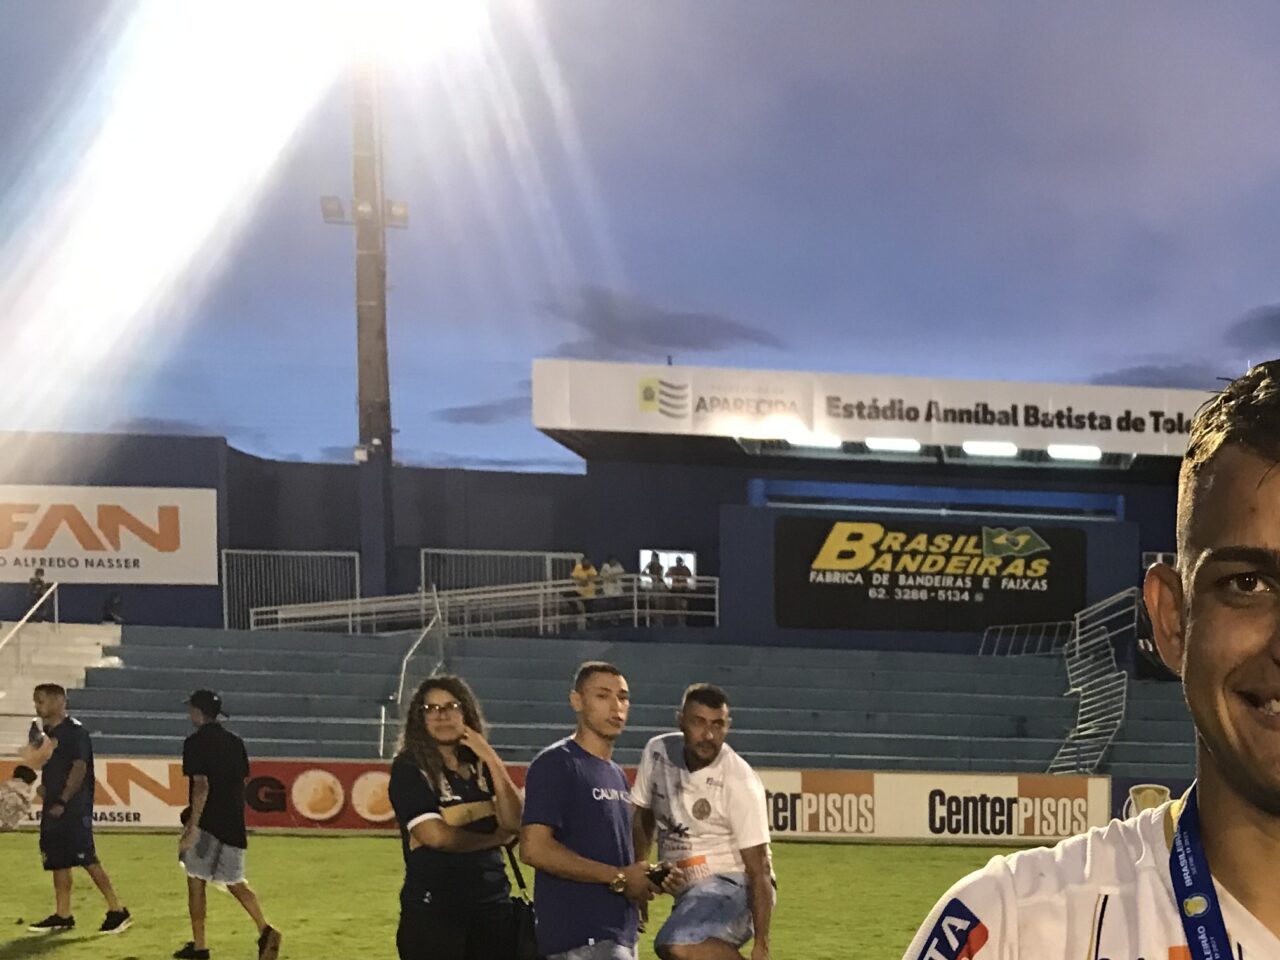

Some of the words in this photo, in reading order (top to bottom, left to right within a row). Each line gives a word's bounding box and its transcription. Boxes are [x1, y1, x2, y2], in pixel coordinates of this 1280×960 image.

[825, 395, 920, 422] Estádio
[1023, 405, 1112, 431] Batista
[1116, 410, 1146, 433] de
[0, 503, 181, 553] FAN
[13, 557, 79, 569] ALFREDO
[85, 558, 141, 569] NASSER
[872, 572, 890, 586] DE
[899, 572, 973, 589] BANDEIRAS
[982, 578, 990, 590] E
[1001, 578, 1048, 591] FAIXAS
[928, 788, 1089, 836] CenterPISOS
